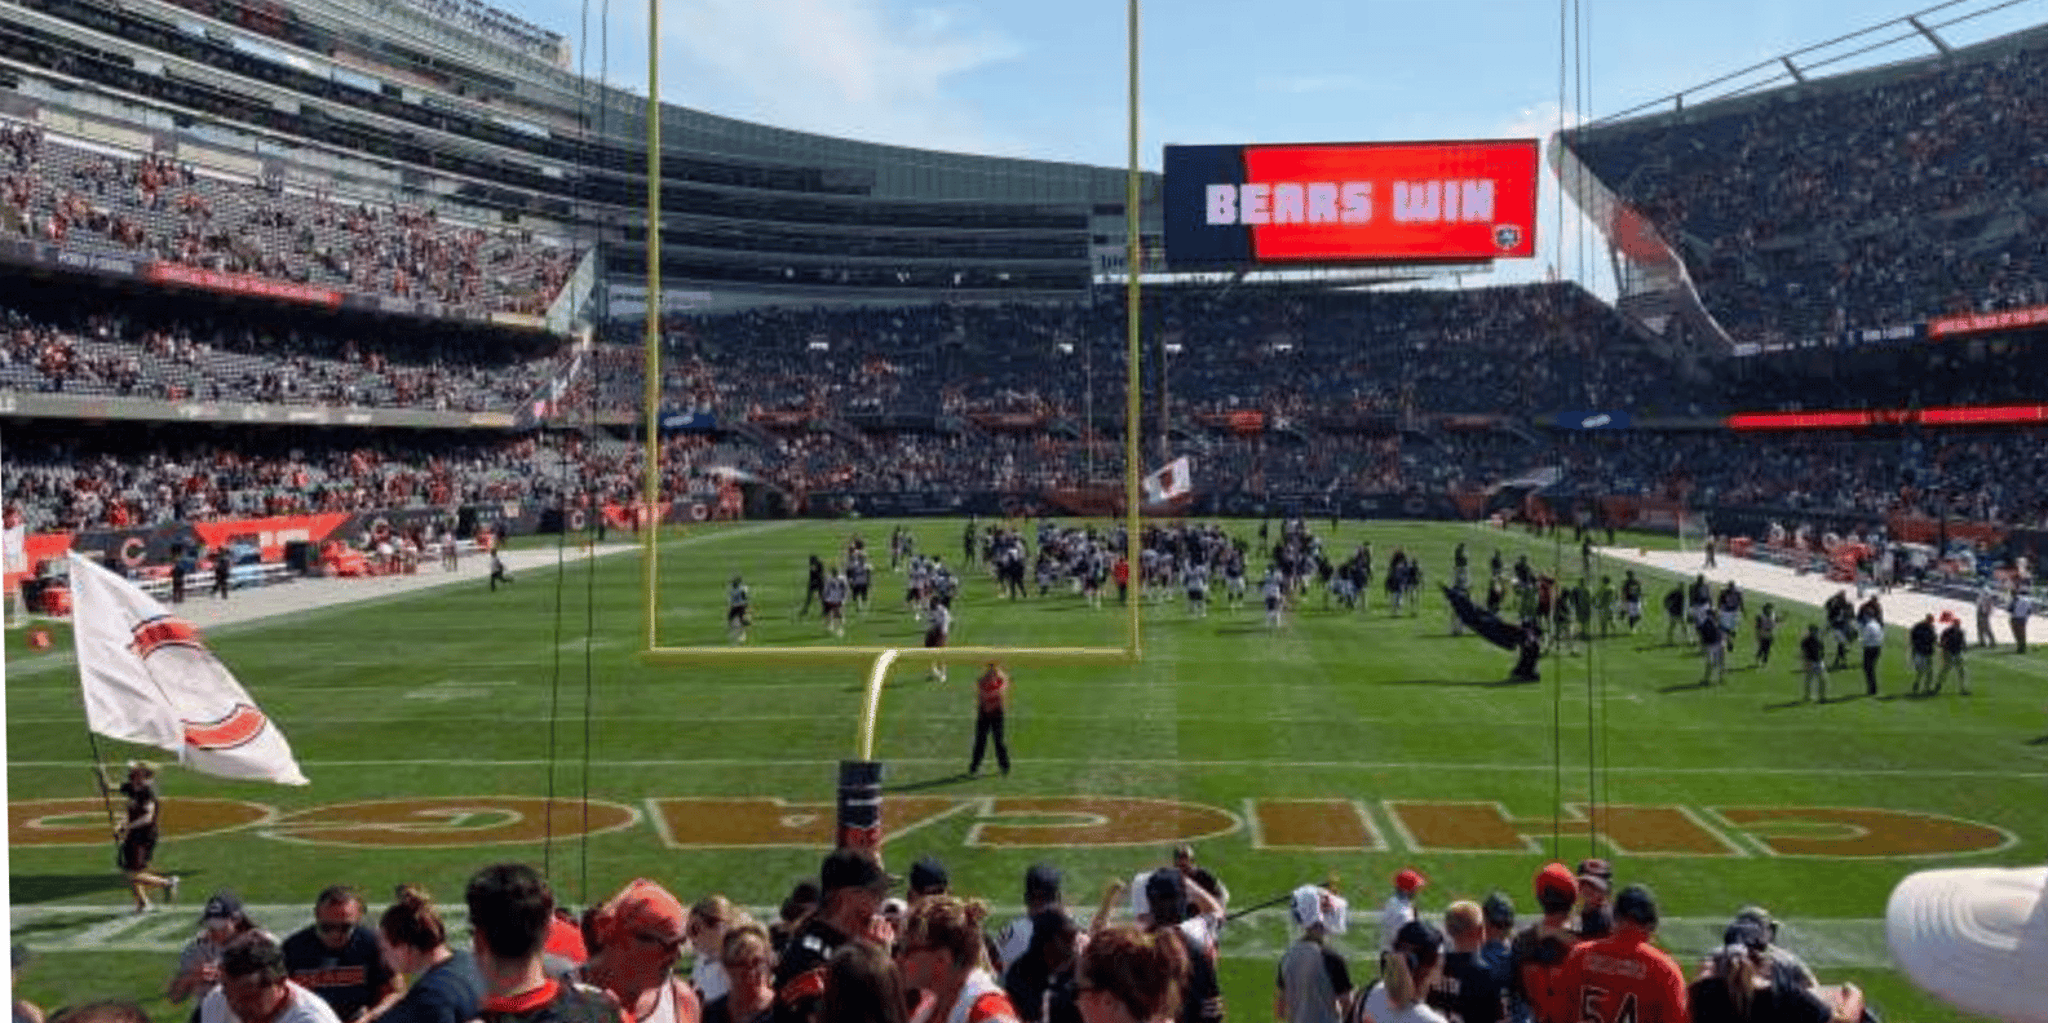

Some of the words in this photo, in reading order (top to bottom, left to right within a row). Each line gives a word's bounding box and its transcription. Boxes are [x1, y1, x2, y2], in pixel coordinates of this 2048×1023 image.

[1206, 181, 1372, 225] BEARS
[1393, 179, 1494, 222] WIN
[8, 796, 2020, 860] CHICAGO
[1580, 984, 1639, 1023] 54
